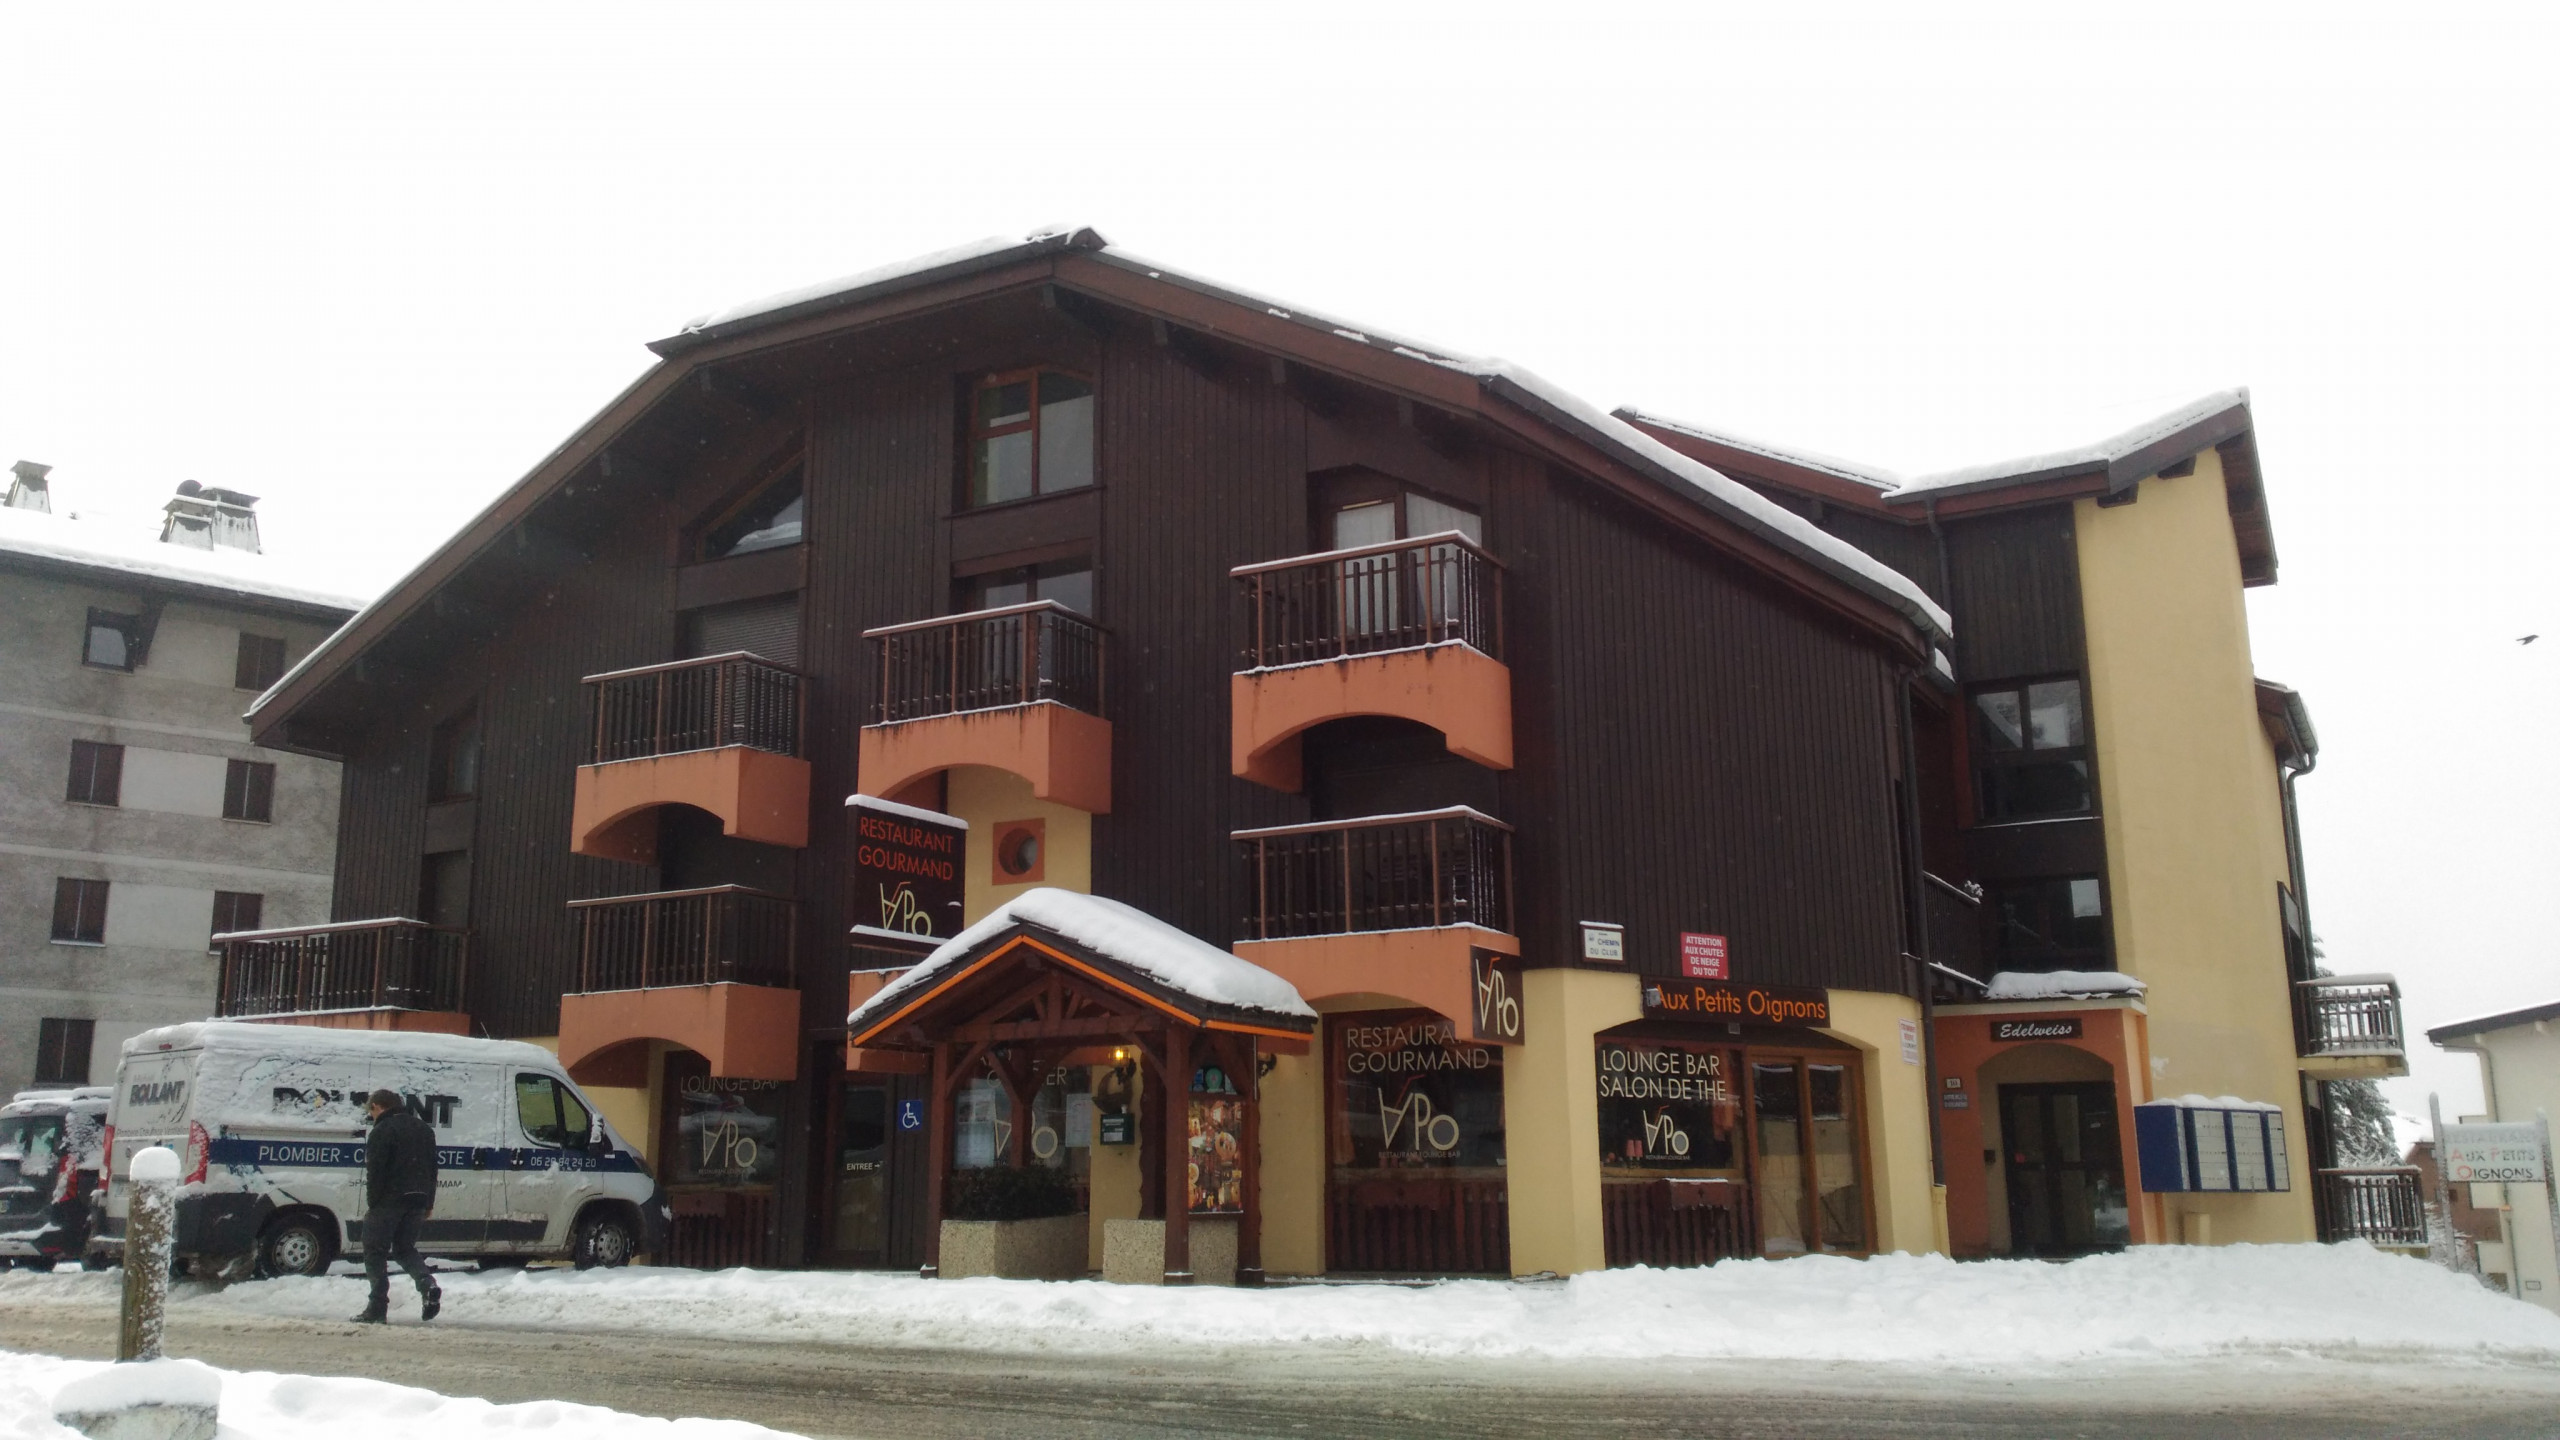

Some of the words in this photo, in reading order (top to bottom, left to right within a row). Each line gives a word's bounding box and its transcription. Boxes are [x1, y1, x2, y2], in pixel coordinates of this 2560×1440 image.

[860, 816, 954, 853] RESTAURANT
[858, 845, 954, 880] GOURMAND
[1686, 935, 1722, 947] ATTENTION
[1684, 946, 1700, 955] AUX
[1700, 948, 1724, 957] CHUTES
[1690, 957, 1700, 965] DE
[1701, 958, 1720, 967] NEIGE
[1693, 967, 1703, 976] DU
[1704, 968, 1718, 977] TOIT
[1695, 986, 1742, 1014] Petits
[1747, 990, 1826, 1023] Oignons
[1347, 1025, 1463, 1048] RESTAURA
[2000, 1023, 2073, 1038] Edelweiss
[1347, 1048, 1490, 1073] GOURMAND
[1602, 1049, 1680, 1074] LOUNGE
[1685, 1053, 1721, 1076] BAR
[1600, 1074, 1663, 1099] SALON
[1668, 1078, 1692, 1100] DE
[1695, 1079, 1727, 1101] THE
[258, 1145, 340, 1163] PLOMBIER
[530, 1156, 543, 1166] 06
[571, 1158, 583, 1168] 24
[585, 1158, 597, 1168] 20
[846, 1162, 873, 1171] ENTREE
[2456, 1165, 2534, 1180] OIGNONS
